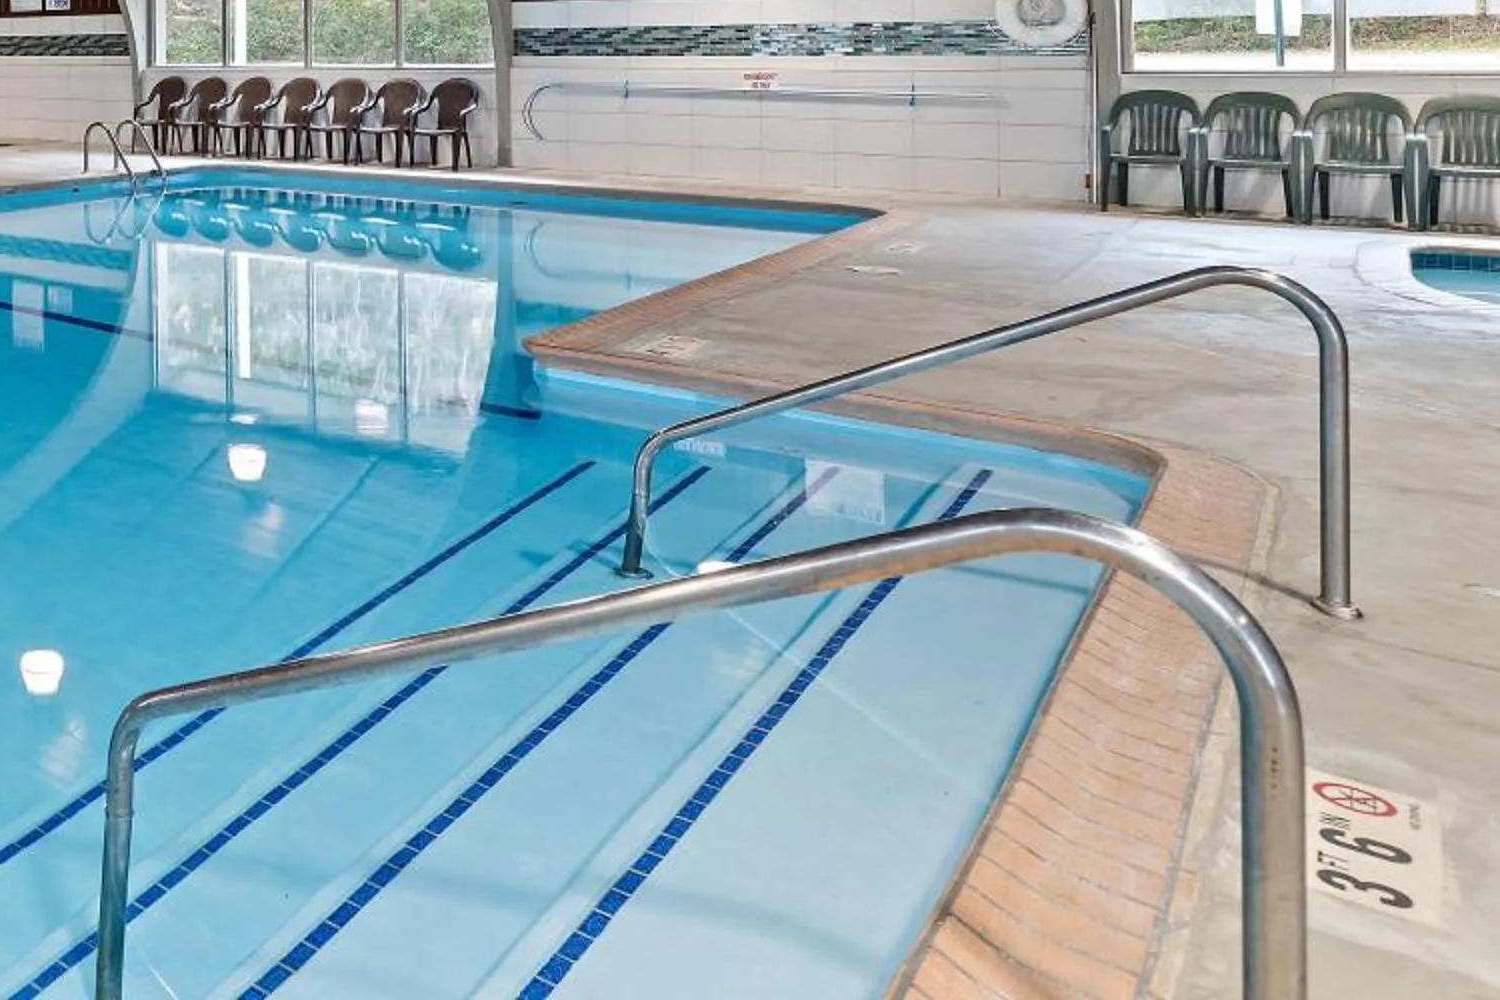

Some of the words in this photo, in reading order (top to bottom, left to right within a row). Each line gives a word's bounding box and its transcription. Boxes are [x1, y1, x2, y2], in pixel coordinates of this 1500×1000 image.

[1316, 850, 1349, 870] FT
[1318, 827, 1413, 864] 6
[1316, 869, 1414, 909] 3
